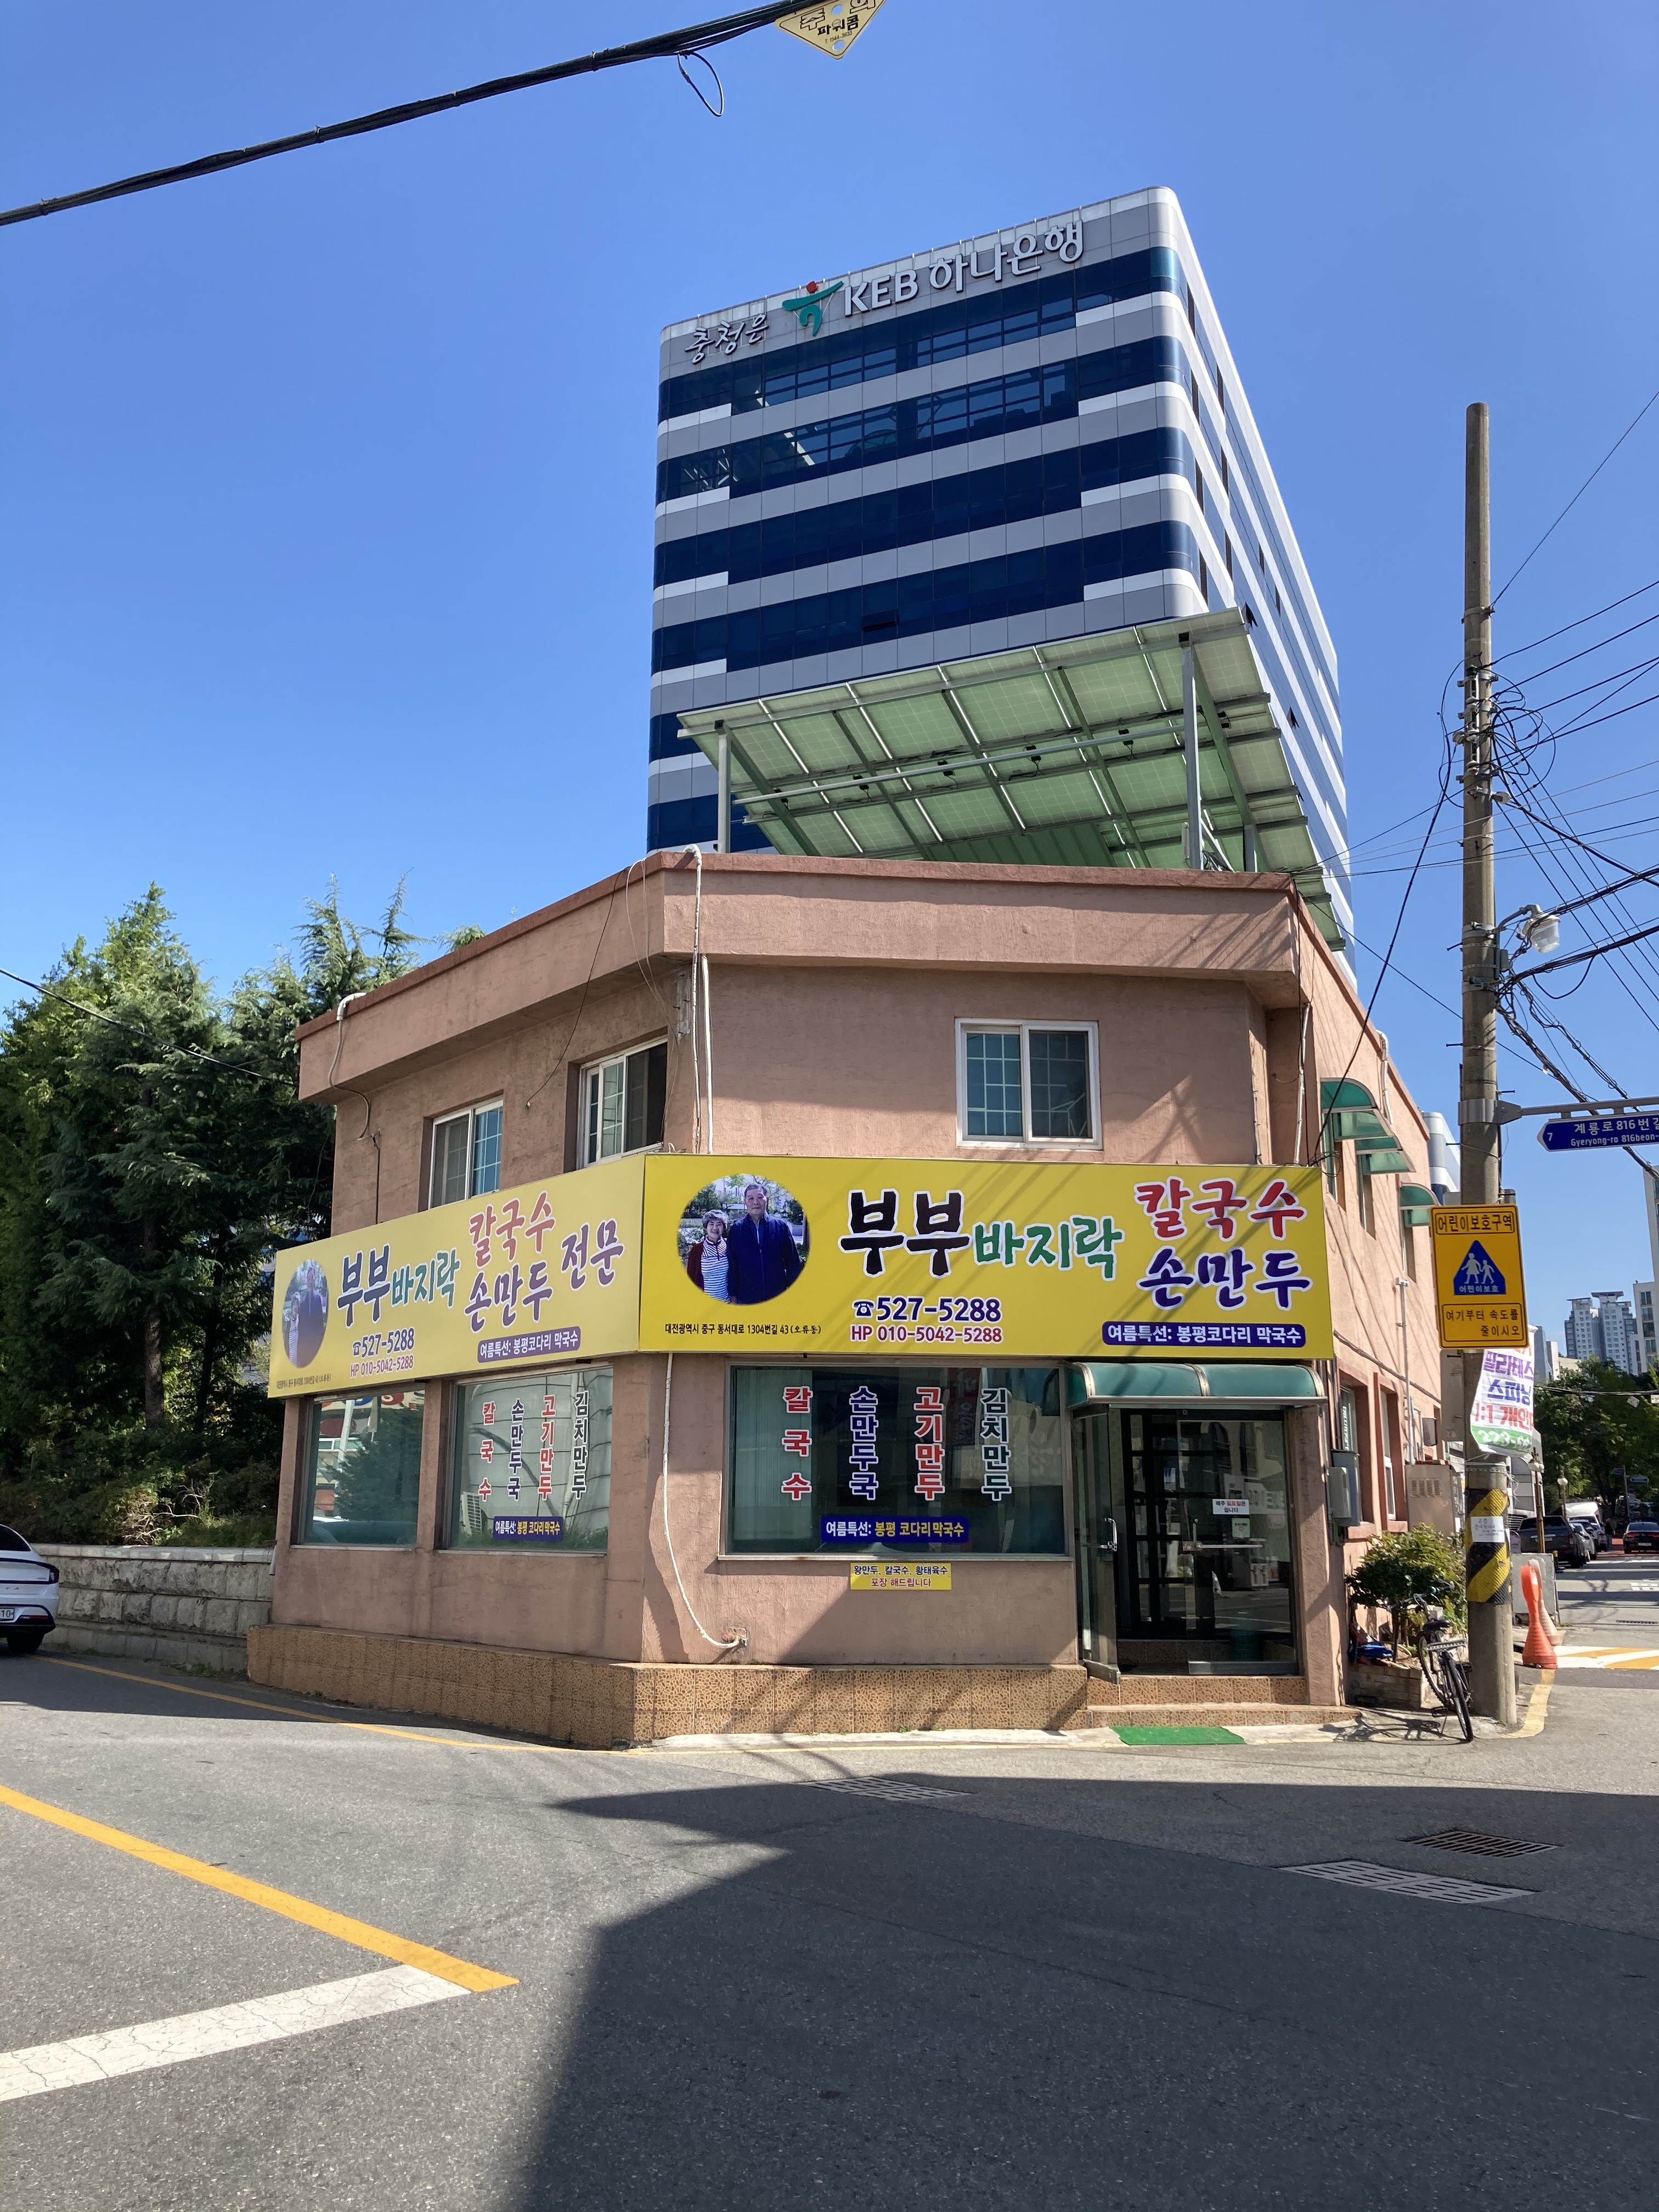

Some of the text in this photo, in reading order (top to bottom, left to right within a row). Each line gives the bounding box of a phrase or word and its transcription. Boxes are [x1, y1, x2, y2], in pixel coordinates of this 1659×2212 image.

[817, 14, 859, 35] 파워콤
[844, 270, 919, 318] KEB
[929, 220, 1084, 292] 하나은행
[1547, 1132, 1553, 1141] 7
[1571, 1137, 1618, 1147] Gyeryong-ro
[1574, 1121, 1614, 1136] 계룡로
[1136, 1177, 1306, 1240] 칼국수
[469, 1190, 555, 1268] 칼국수
[839, 1189, 1122, 1279] 부부 바지락
[1438, 1214, 1513, 1232] 어린이보호구역
[562, 1219, 624, 1290] 전문
[337, 1244, 460, 1327] 부부 바지락
[1138, 1247, 1312, 1309] 손만두
[1459, 1285, 1499, 1293] 어린이보호
[465, 1262, 553, 1333] 손만두
[877, 1297, 1001, 1322] 527-5288
[665, 1323, 699, 1334] 대전광역시
[702, 1323, 715, 1334] 중구
[718, 1324, 744, 1334] 동서대로
[747, 1324, 777, 1335] 1304번길
[1446, 1308, 1519, 1322] 여기부터 속도를
[362, 1328, 414, 1358] 527-5288
[480, 1330, 578, 1359] 여름특선: 봉평코다리 막국수
[852, 1326, 1002, 1342] HP 010-5042-5288
[1108, 1325, 1301, 1344] 여름특선: 봉평코다리 막국수
[1481, 1325, 1520, 1337] 줄이시오
[351, 1355, 413, 1377] HP 010-5042-5288
[1483, 1351, 1534, 1381] 필라테스
[1487, 1379, 1532, 1406] 스피닝
[1475, 1402, 1493, 1424] 1:1
[478, 1401, 496, 1502] 칼국수
[507, 1398, 524, 1502] 손만두국
[538, 1395, 556, 1501] 고기만두
[571, 1390, 589, 1500] 김치만두
[782, 1386, 812, 1501] 칼국수
[849, 1386, 879, 1501] 손만두국
[913, 1386, 945, 1502] 고기만두
[979, 1387, 1012, 1502] 김치만두
[495, 1520, 516, 1535] 여름특선:
[826, 1521, 872, 1537] 여름특선:
[874, 1521, 896, 1537] 봉평
[853, 1565, 948, 1576] 왕만두, 칼국수, 황태육수
[870, 1578, 931, 1587] 포장 해드립니다
